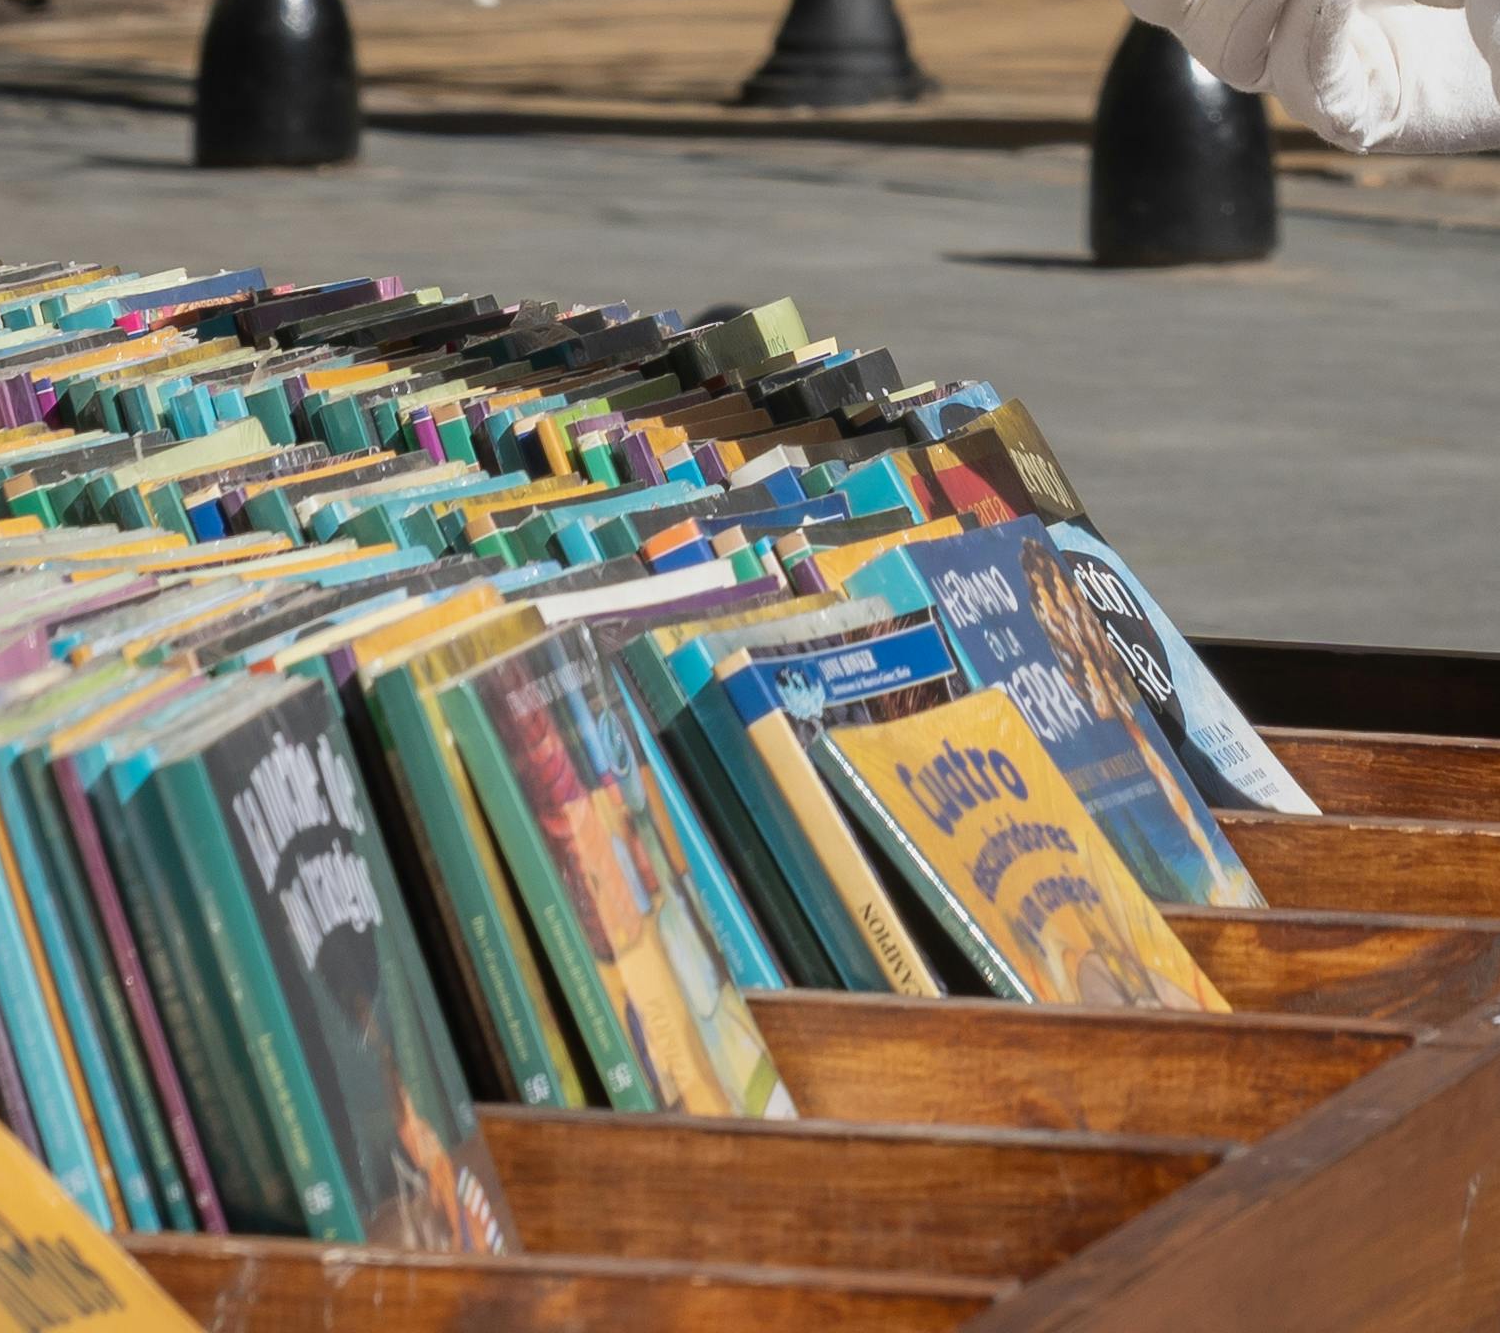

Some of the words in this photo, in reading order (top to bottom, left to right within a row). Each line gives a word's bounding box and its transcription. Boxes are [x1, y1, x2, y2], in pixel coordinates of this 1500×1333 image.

[931, 564, 1019, 629] HERMANO
[1074, 561, 1143, 620] ción
[894, 736, 1030, 837] Cuatro
